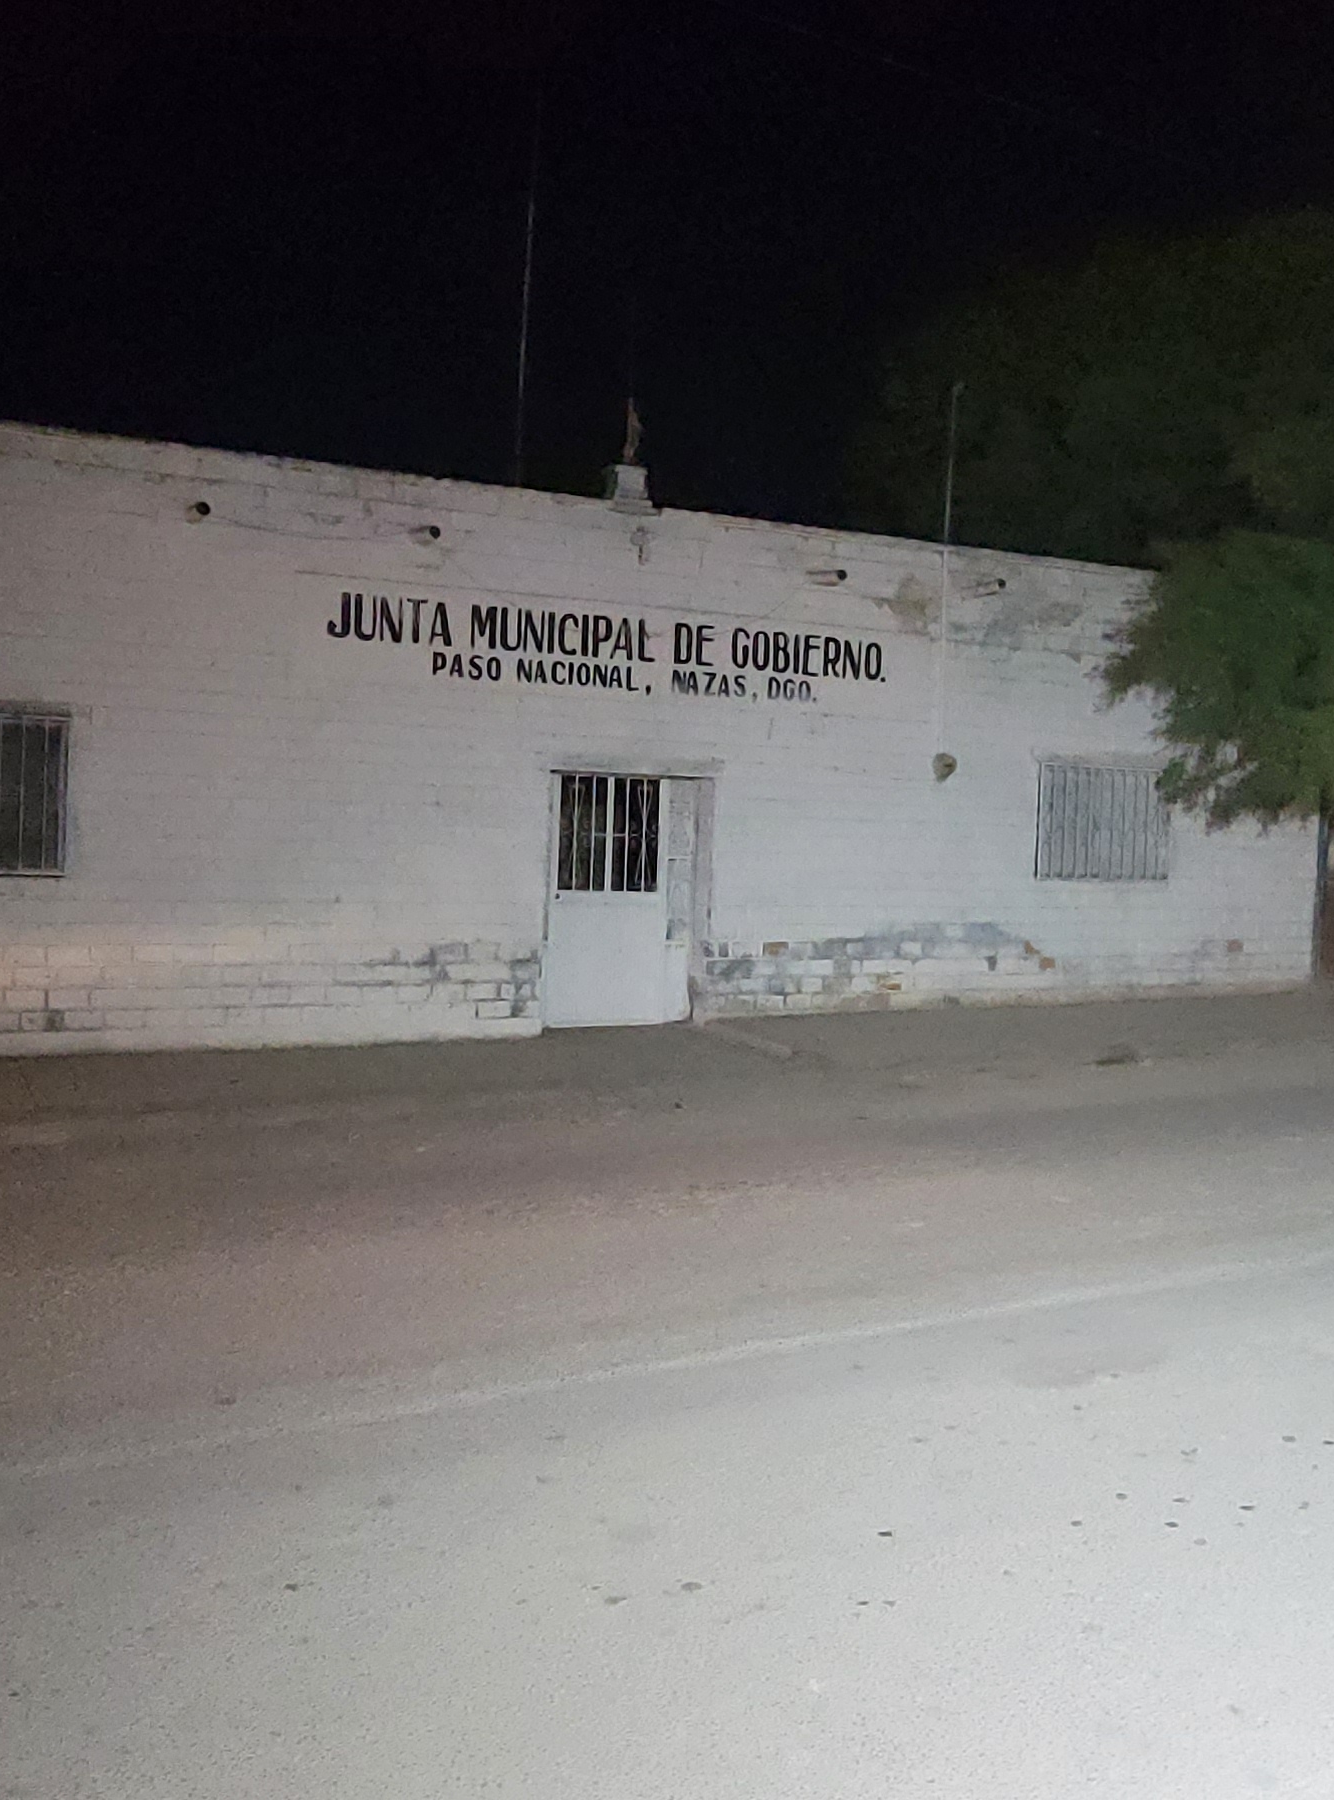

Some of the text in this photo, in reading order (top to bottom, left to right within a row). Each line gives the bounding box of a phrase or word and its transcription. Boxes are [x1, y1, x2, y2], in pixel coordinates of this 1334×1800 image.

[327, 592, 886, 683] JUNTA MUNICIPAL DE GOBIERNO.
[431, 653, 817, 703] PASO NACIONAL, NAZAS, DGO.
